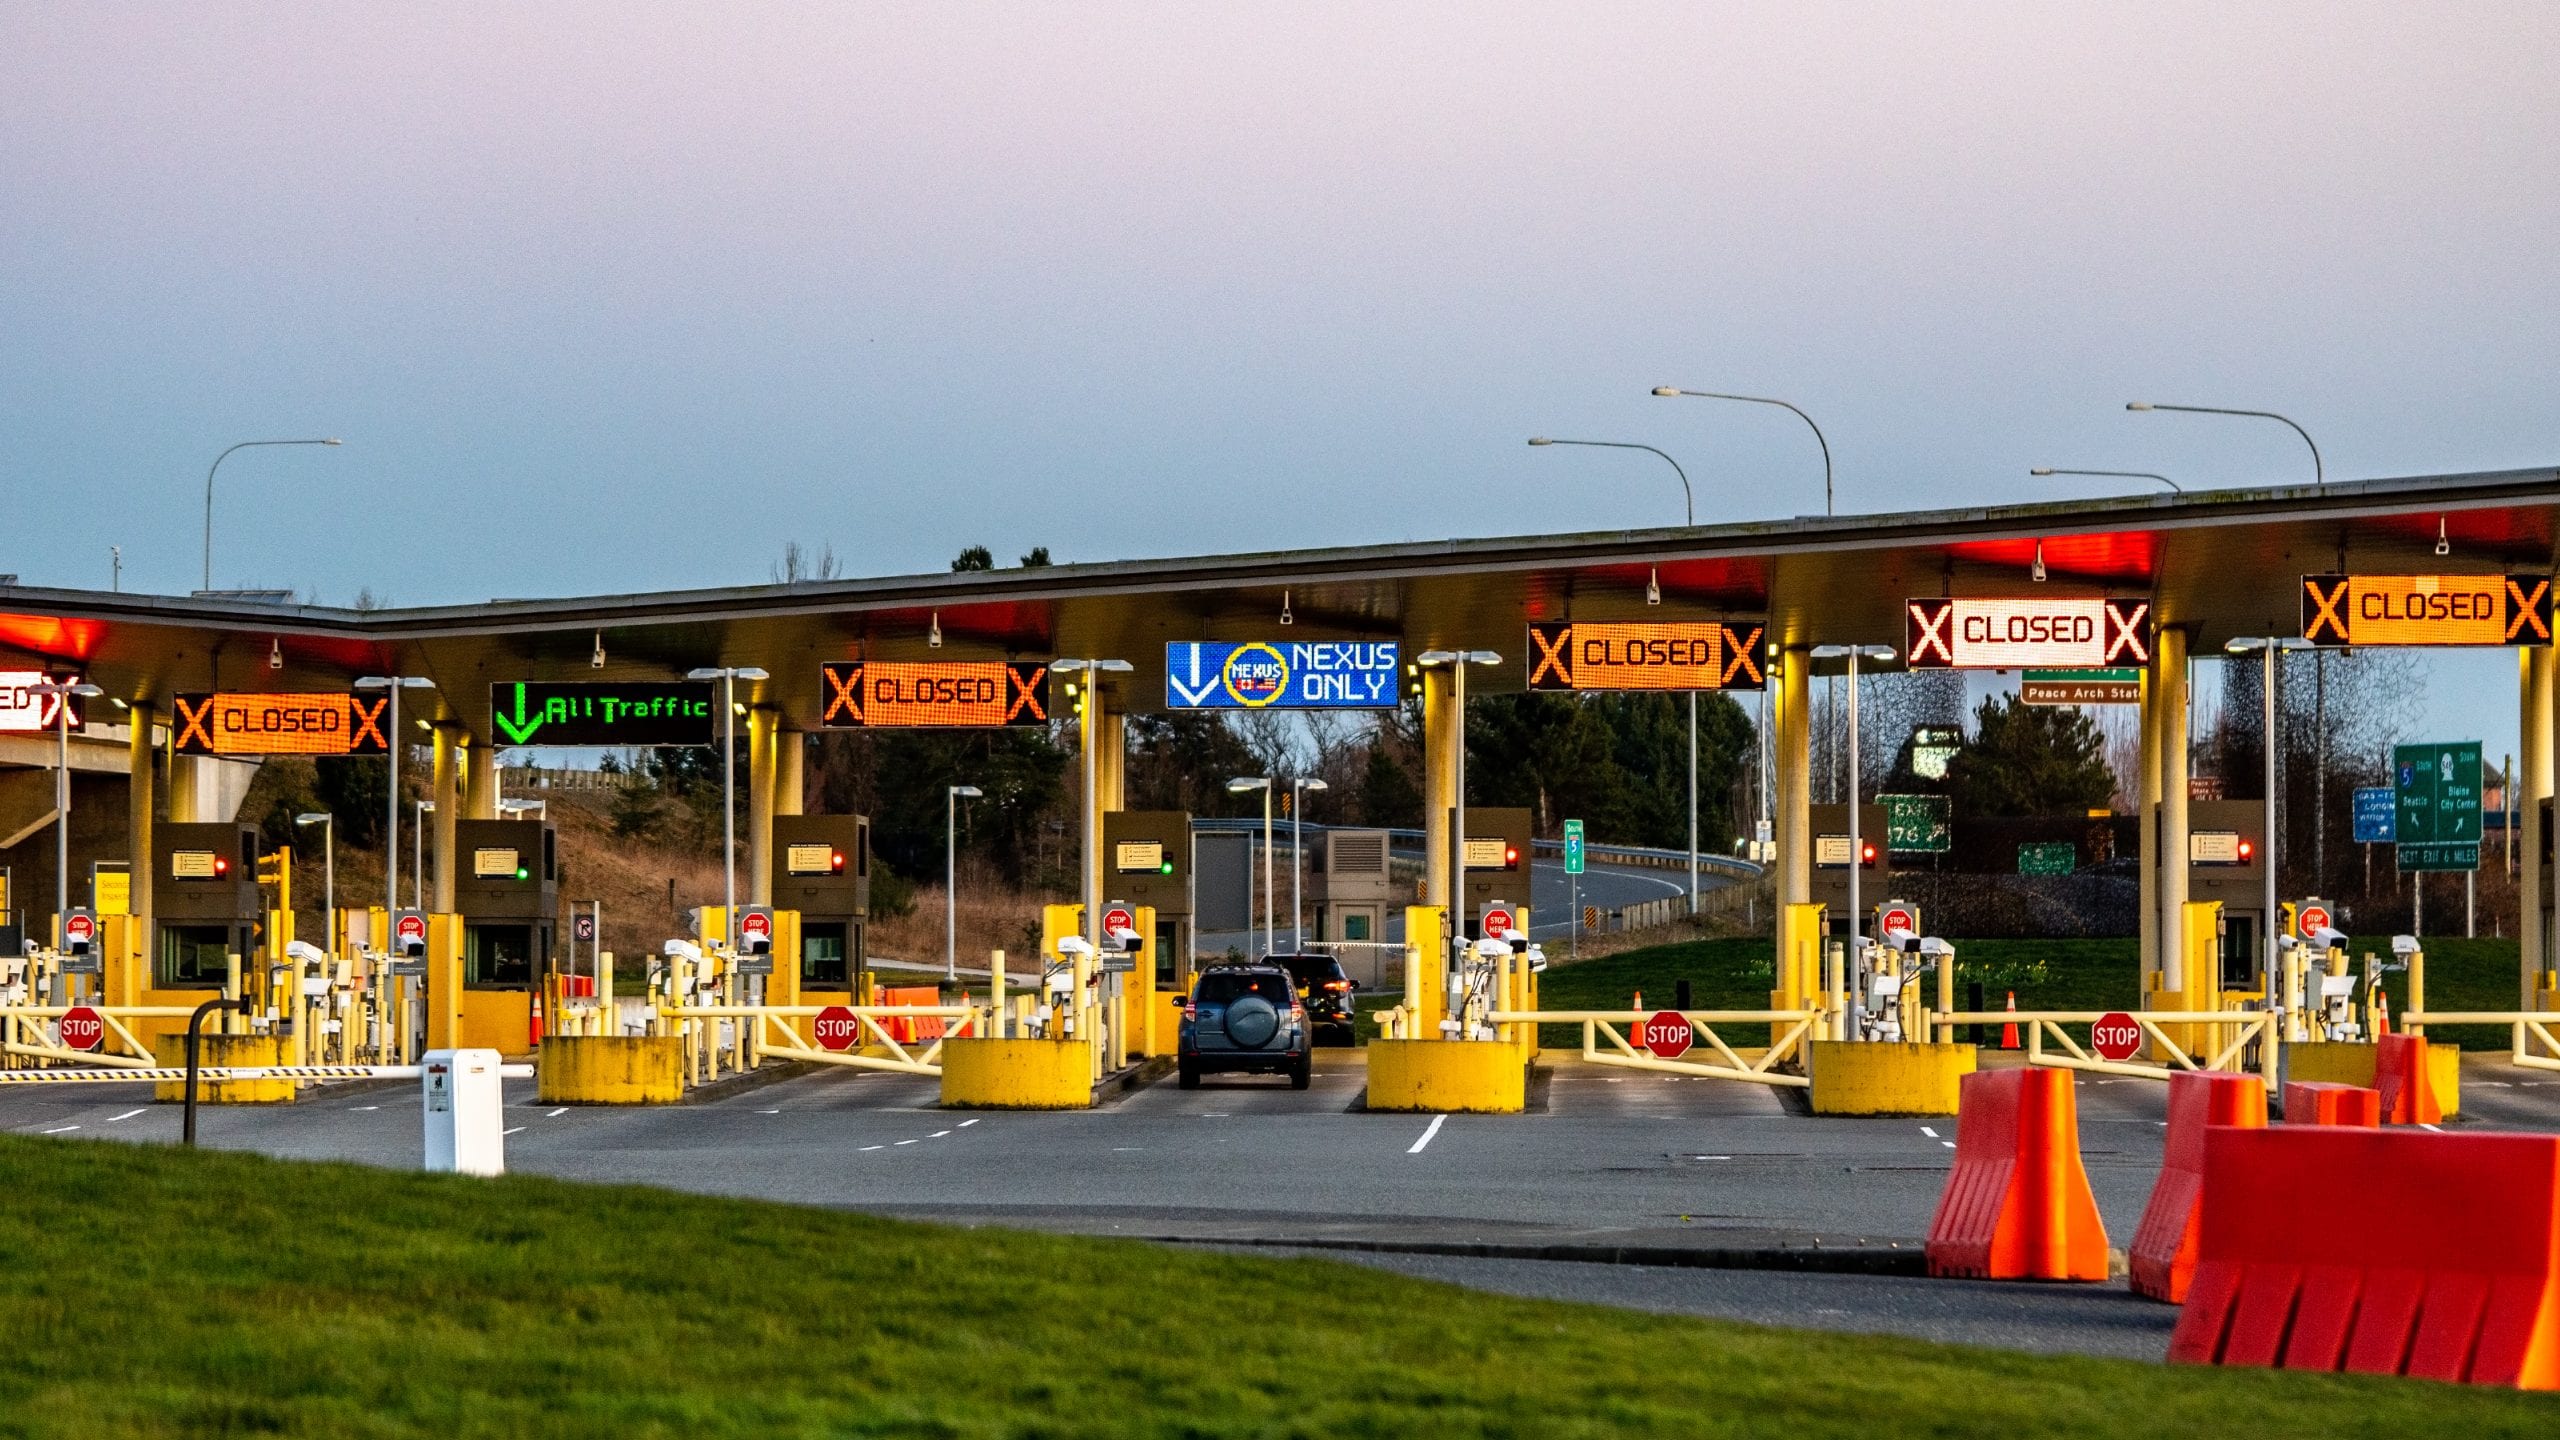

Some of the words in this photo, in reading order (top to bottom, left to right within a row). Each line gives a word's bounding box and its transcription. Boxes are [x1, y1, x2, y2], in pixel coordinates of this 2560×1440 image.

[2361, 592, 2493, 620] CLOSED
[1964, 616, 2093, 643] CLOSED
[1293, 643, 1396, 671] NEXUS
[1584, 639, 1710, 666] CLOSED
[1231, 663, 1282, 678] NEXUS
[875, 678, 995, 703] CLOSED
[1303, 673, 1386, 700] ONLY
[2029, 687, 2067, 699] Peace
[2074, 687, 2104, 699] Arch
[545, 697, 592, 723] All
[599, 697, 708, 723] Traffic
[224, 708, 339, 732] CLOSED
[2403, 768, 2410, 785] 5
[2440, 798, 2454, 812] City
[1571, 840, 1577, 853] 5
[2444, 850, 2450, 862] 6
[72, 921, 89, 929] STOP
[403, 922, 419, 930] STOP
[748, 919, 765, 927] STOP
[1109, 916, 1126, 924] STOP
[1490, 916, 1507, 924] STOP
[1889, 916, 1906, 924] STOP
[2306, 914, 2323, 922] STOP
[62, 1019, 101, 1036] STOP
[816, 1019, 856, 1037] STOP
[1647, 1026, 1689, 1043] STOP
[2095, 1027, 2138, 1046] STOP
